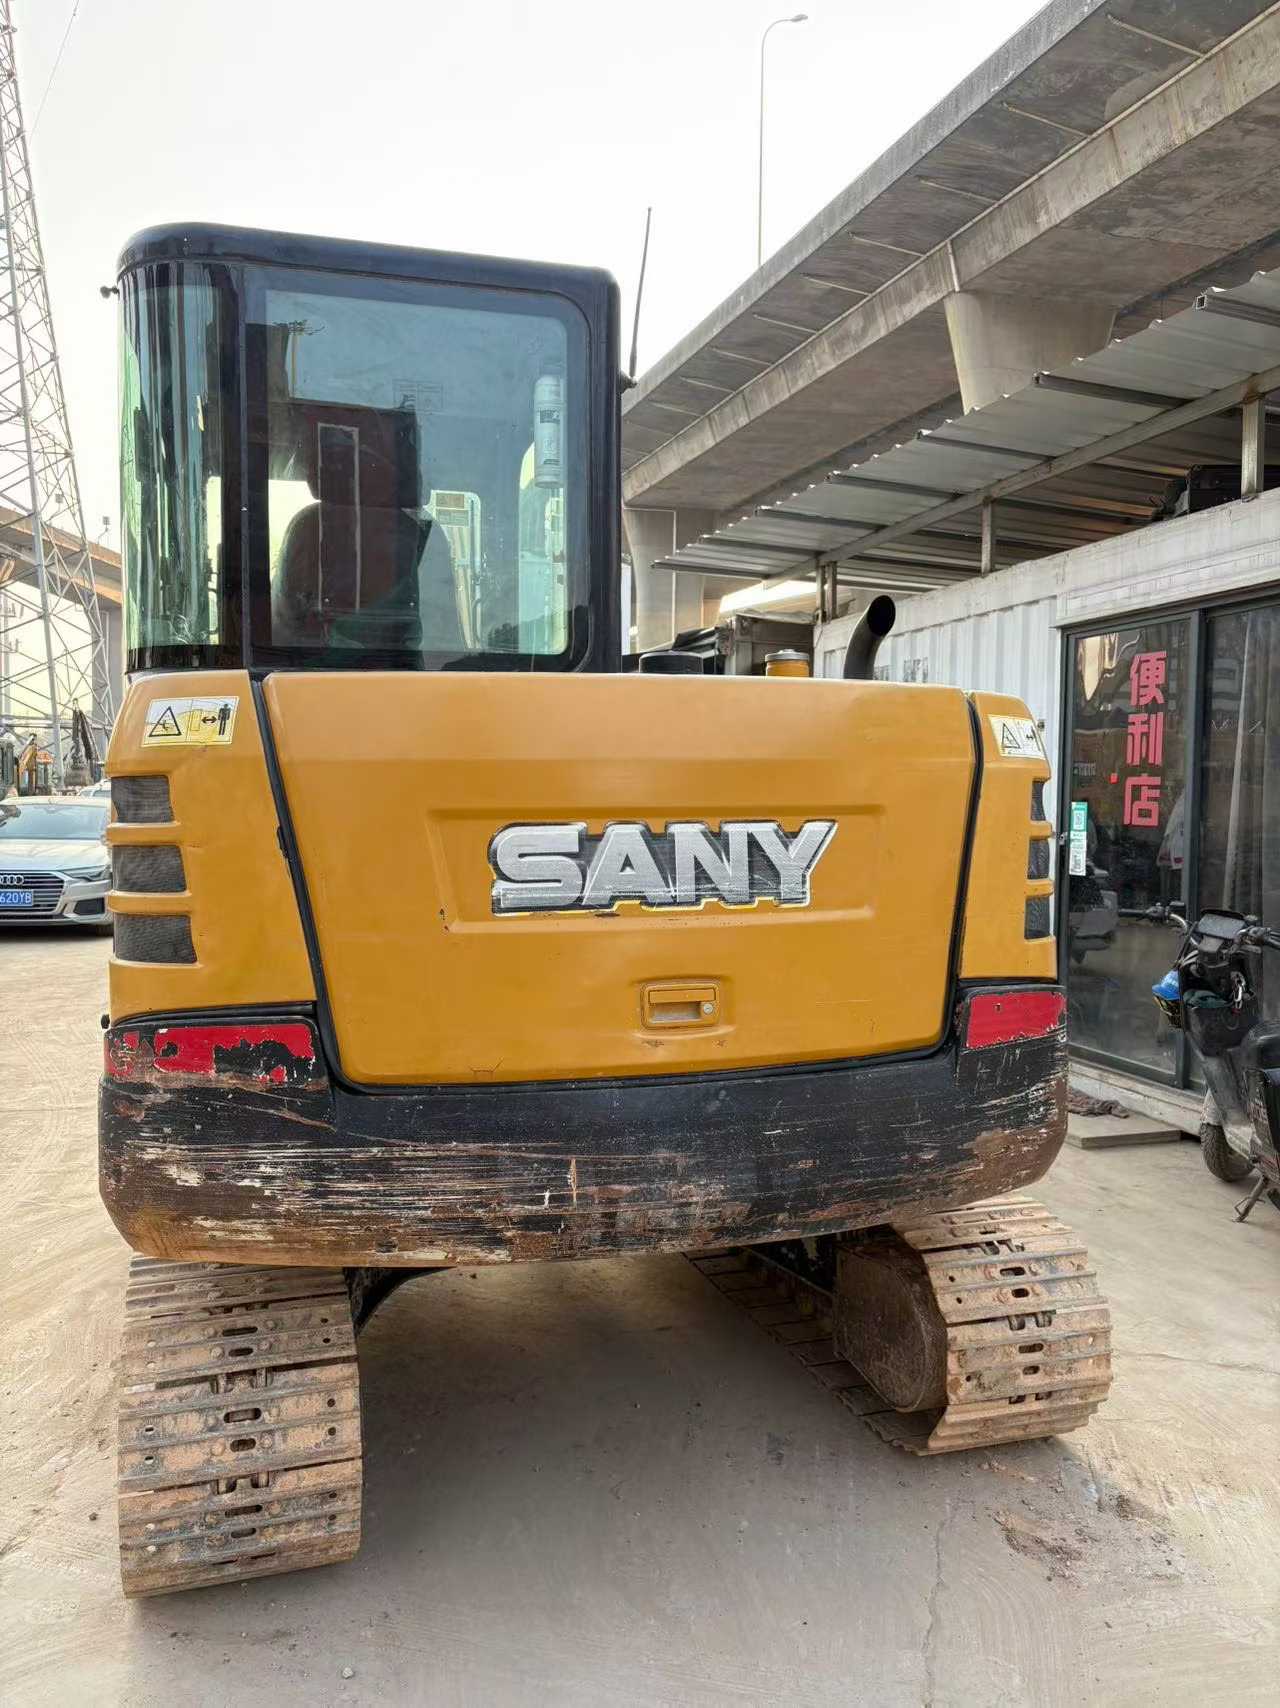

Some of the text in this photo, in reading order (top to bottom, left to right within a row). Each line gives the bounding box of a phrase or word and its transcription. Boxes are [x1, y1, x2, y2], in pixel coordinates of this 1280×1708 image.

[1124, 651, 1168, 827] 便利店
[489, 821, 837, 914] SANY
